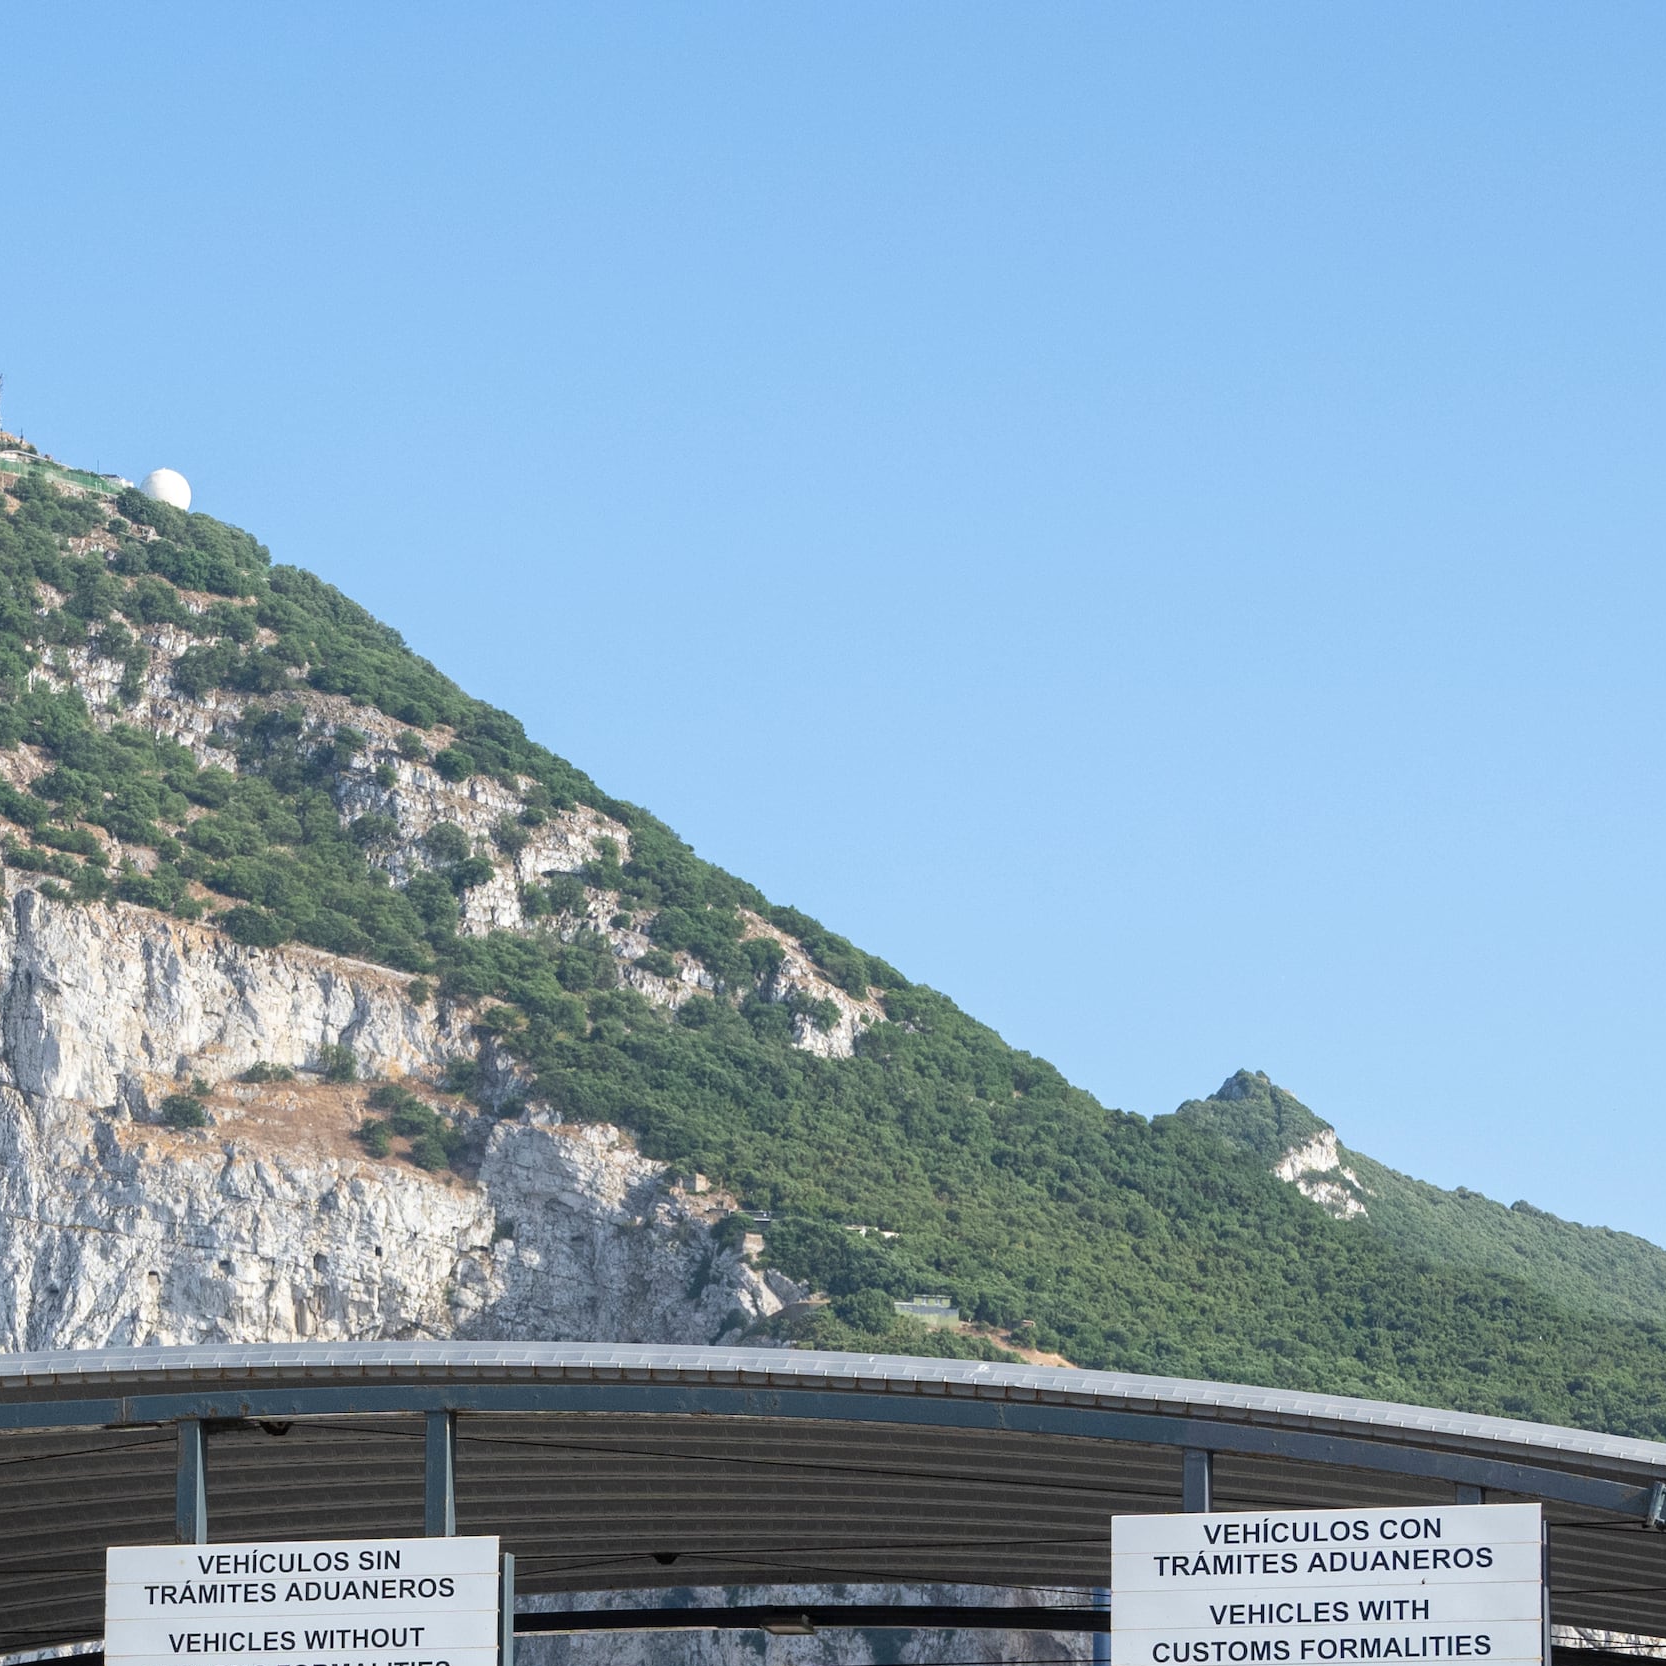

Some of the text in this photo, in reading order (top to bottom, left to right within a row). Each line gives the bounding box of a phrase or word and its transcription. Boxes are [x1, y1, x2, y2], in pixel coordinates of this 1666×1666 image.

[1204, 1518, 1440, 1544] VEHÍCULOS CON
[198, 1550, 400, 1574] VEHÍCULOS SIN
[1154, 1548, 1492, 1576] TRÁMITES ADUANEROS
[145, 1578, 454, 1604] TRÁMITES ADUANEROS
[1210, 1600, 1428, 1624] VEHICLES WITH
[169, 1628, 424, 1652] VEHICLES WITHOUT
[1153, 1635, 1490, 1662] CUSTOMS FORMALITIES
